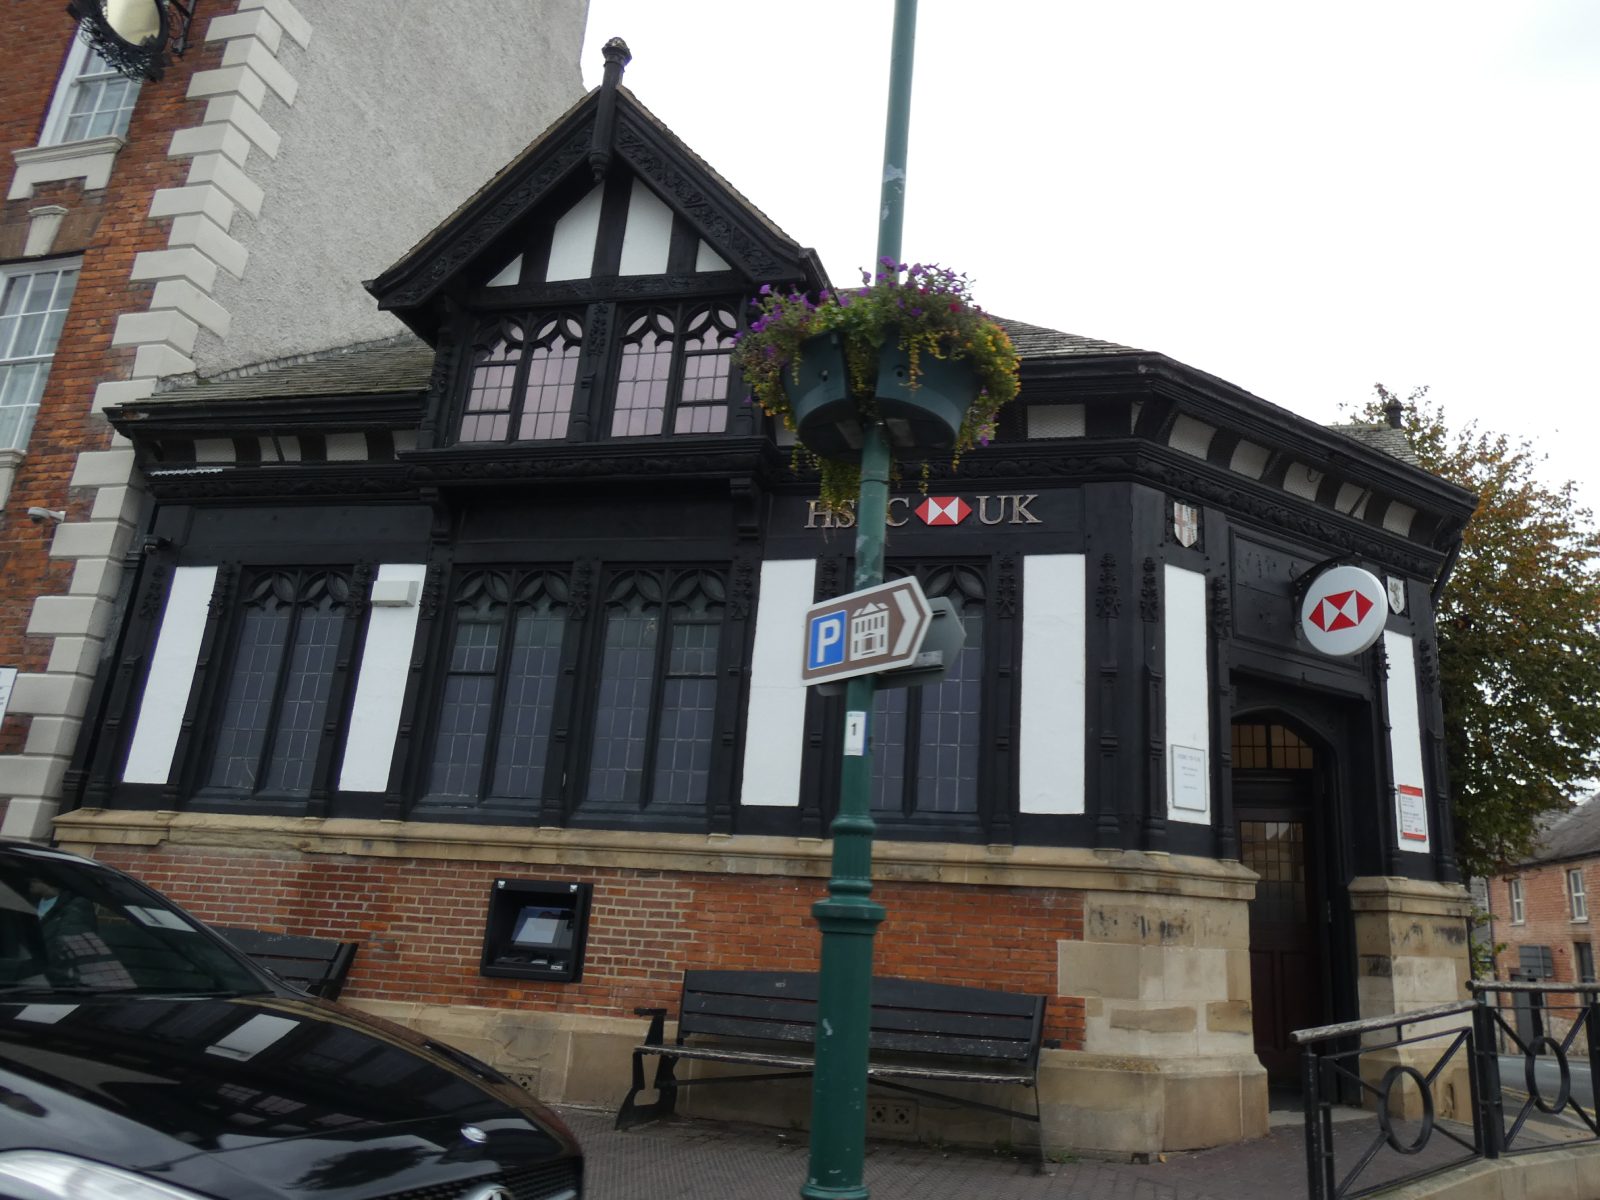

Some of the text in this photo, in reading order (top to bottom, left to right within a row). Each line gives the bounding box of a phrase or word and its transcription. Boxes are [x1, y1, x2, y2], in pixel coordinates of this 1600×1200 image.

[804, 494, 1043, 529] HSC UK
[816, 618, 841, 663] P
